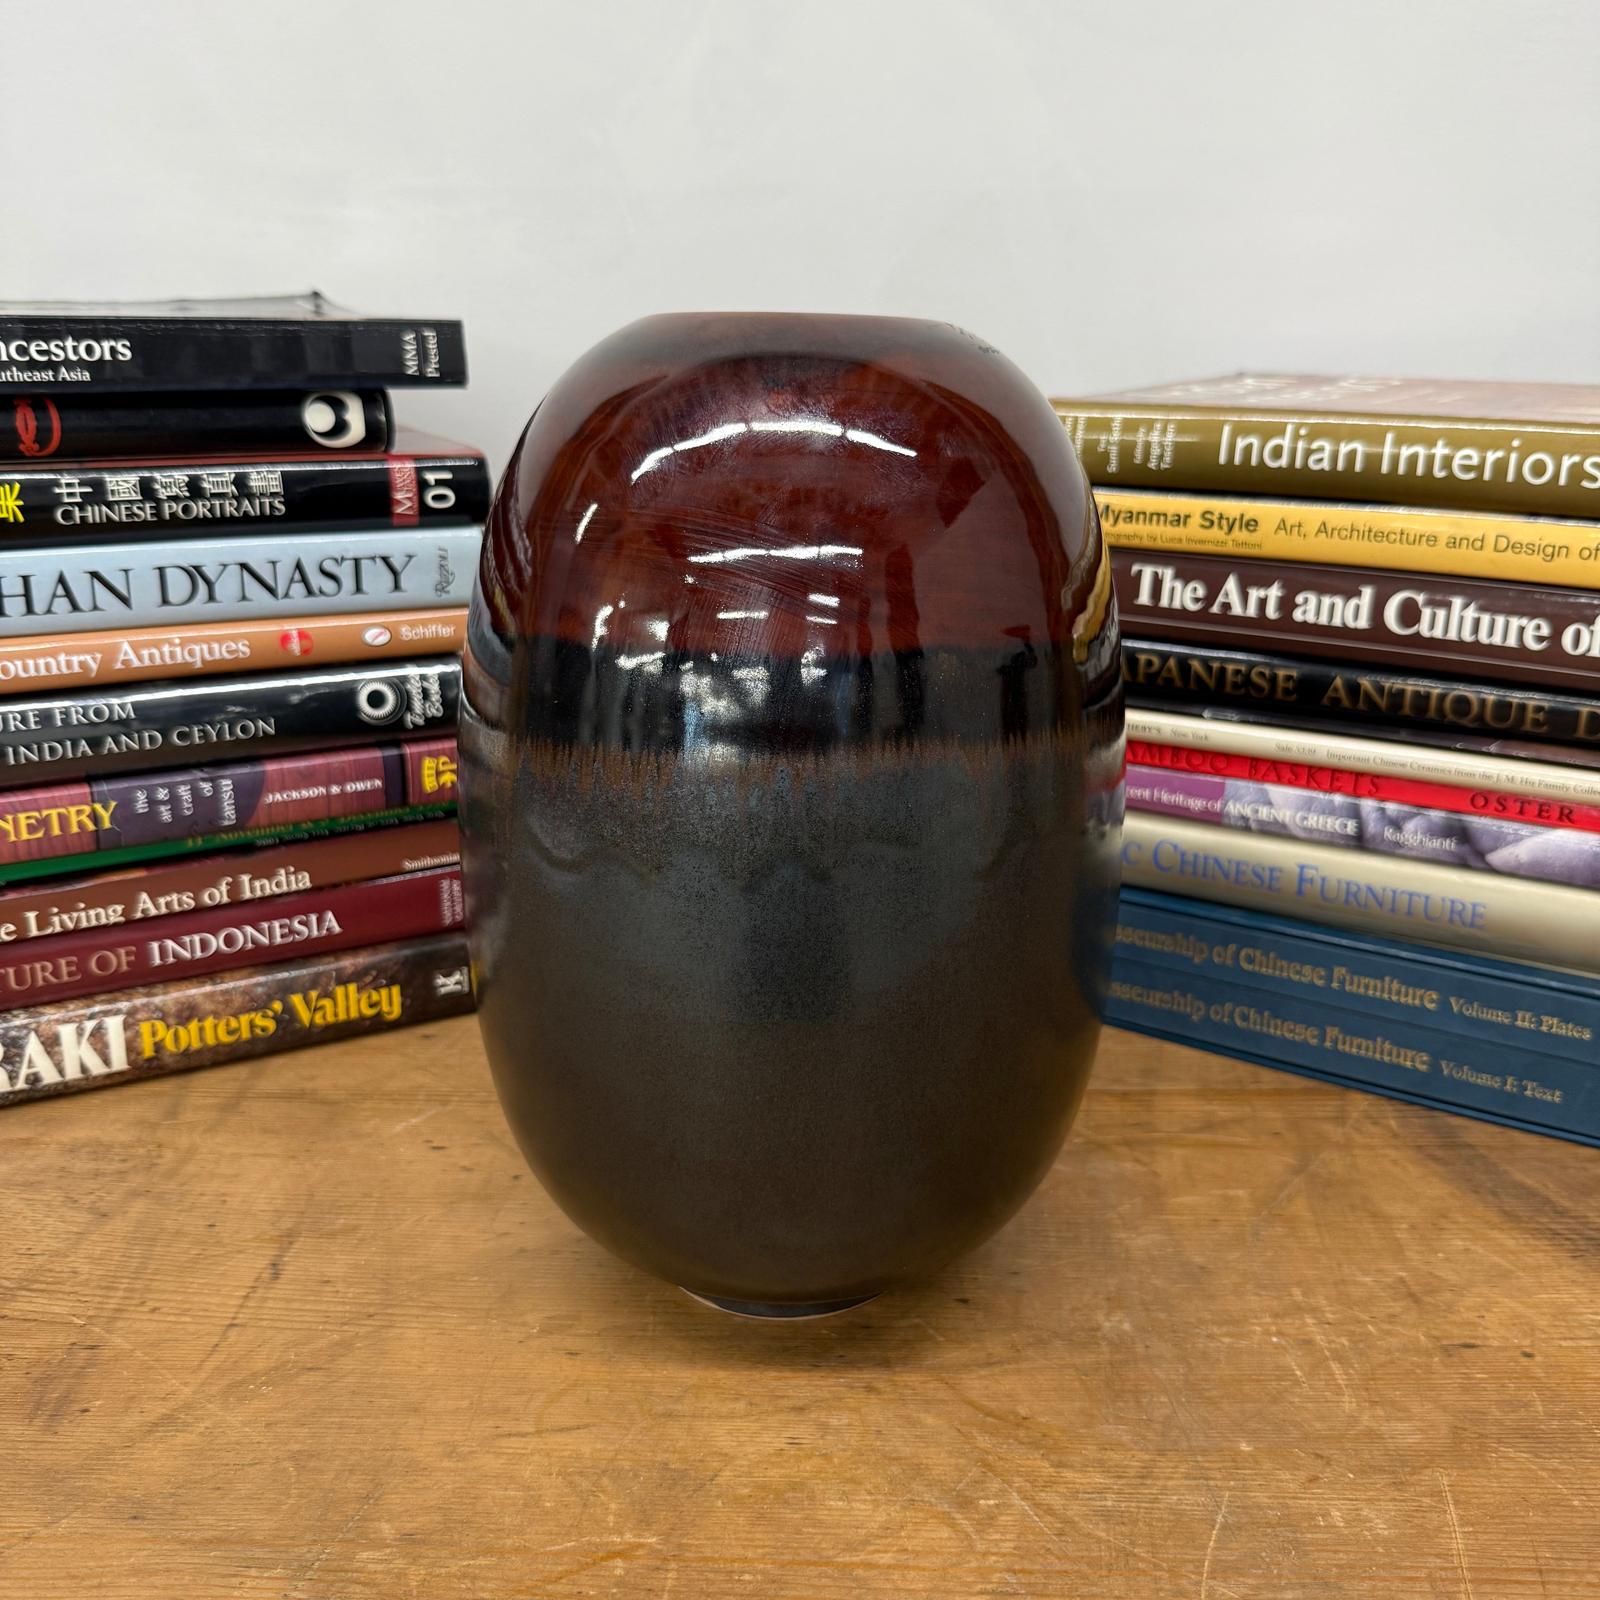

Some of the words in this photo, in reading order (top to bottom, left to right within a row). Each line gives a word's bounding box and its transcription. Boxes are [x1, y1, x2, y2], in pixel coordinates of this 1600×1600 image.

[58, 365, 91, 382] Asia
[402, 331, 420, 375] MMA
[423, 328, 440, 377] Prestel
[1218, 422, 1369, 472] Indian
[1380, 430, 1600, 489] Interiors
[55, 502, 157, 525] CHINESE
[163, 496, 286, 519] PORTRAITS
[422, 470, 456, 509] 01
[1160, 534, 1183, 545] Luca
[1199, 510, 1260, 535] Style
[1274, 518, 1307, 538] Art,
[1315, 521, 1438, 547] Architecture
[1445, 532, 1484, 552] and
[1494, 535, 1570, 562] Design
[0, 570, 134, 617] HAN
[153, 552, 417, 608] DYNASTY
[1131, 563, 1204, 611] The
[1215, 571, 1285, 620] Art
[1292, 584, 1375, 631] and
[1383, 590, 1553, 652] Culture
[114, 637, 251, 671] Antiques
[401, 623, 456, 641] Schiffer
[53, 702, 137, 728] FROM
[1320, 673, 1550, 734] ANTIQUE
[6, 738, 95, 766] INDIA
[101, 729, 163, 757] AND
[171, 717, 277, 748] CEYLON
[265, 785, 327, 805] JACKSON
[329, 783, 343, 795] &
[346, 778, 383, 793] OWEN
[1247, 758, 1381, 796] BASKETS
[1326, 749, 1371, 764] Important
[1373, 755, 1408, 769] Chinese
[1410, 760, 1453, 776] Ceramics
[1479, 769, 1495, 781] the
[1537, 778, 1570, 794] Family
[133, 789, 149, 814] the
[175, 784, 194, 816] craft
[216, 778, 237, 827] tansu
[1153, 786, 1207, 814] Heritage
[1207, 796, 1222, 813] of
[1223, 799, 1294, 825] ANCIENT
[1295, 811, 1359, 836] GREECE
[1469, 791, 1577, 825] OSTER
[23, 902, 126, 938] Living
[132, 891, 196, 920] Arts
[201, 881, 235, 908] of
[238, 866, 312, 898] India
[90, 946, 137, 976] OF
[148, 911, 343, 967] INDONESIA
[1212, 943, 1237, 968] of
[1239, 946, 1326, 988] Chinese
[1331, 967, 1438, 1011] Furniture
[1450, 996, 1512, 1025] Volume
[1538, 1015, 1593, 1040] Plates
[140, 1003, 284, 1060] Potters'
[289, 983, 402, 1030] Valley
[1210, 1002, 1233, 1024] of
[1234, 1006, 1318, 1046] Chinese
[1323, 1026, 1431, 1073] Furniture
[1440, 1060, 1502, 1089] Volume
[1522, 1079, 1563, 1104] Text
